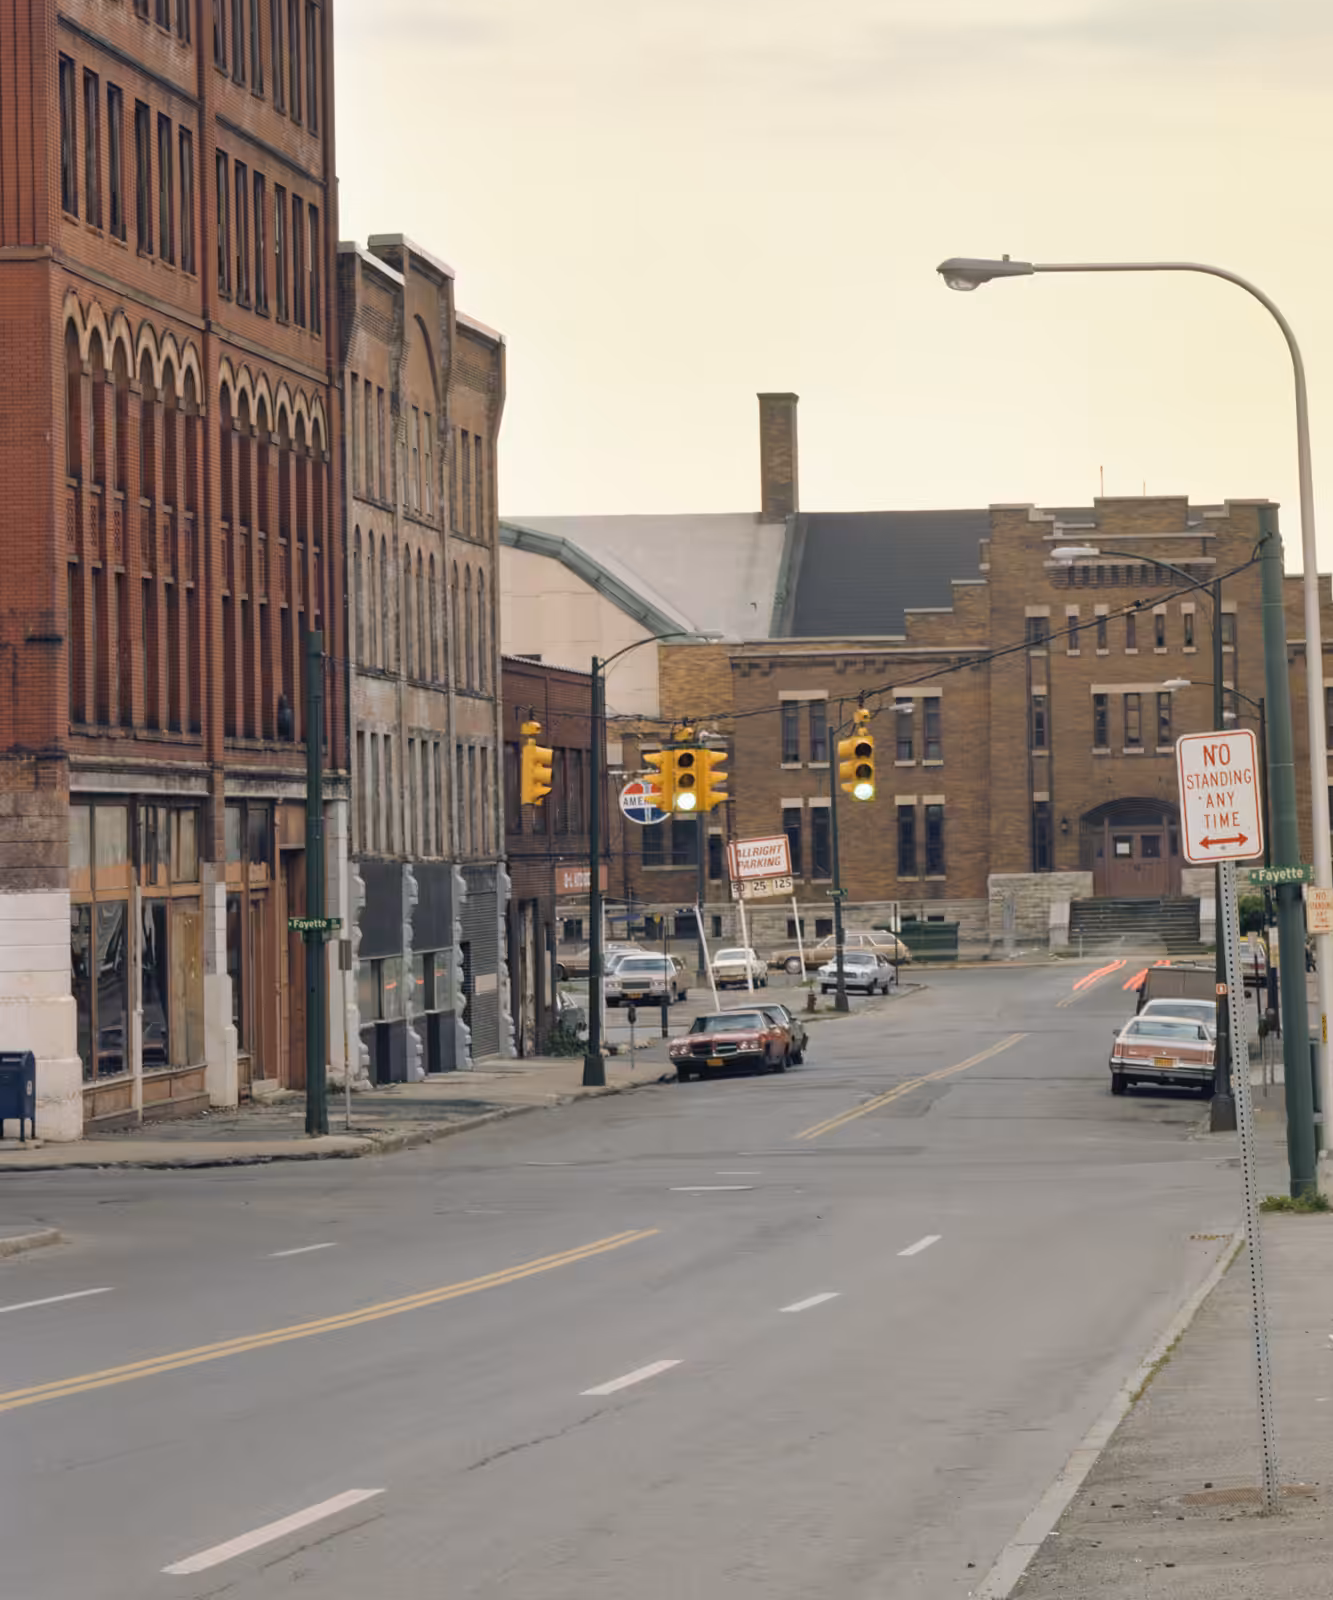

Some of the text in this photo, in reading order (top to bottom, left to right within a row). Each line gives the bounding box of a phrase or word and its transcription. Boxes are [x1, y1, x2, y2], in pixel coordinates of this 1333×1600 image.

[1203, 744, 1231, 767] NO
[1186, 768, 1252, 791] STANDING
[1206, 792, 1235, 809] ANY
[1204, 811, 1241, 829] TIME
[1259, 867, 1304, 883] Fayette
[293, 919, 327, 930] Fayette
